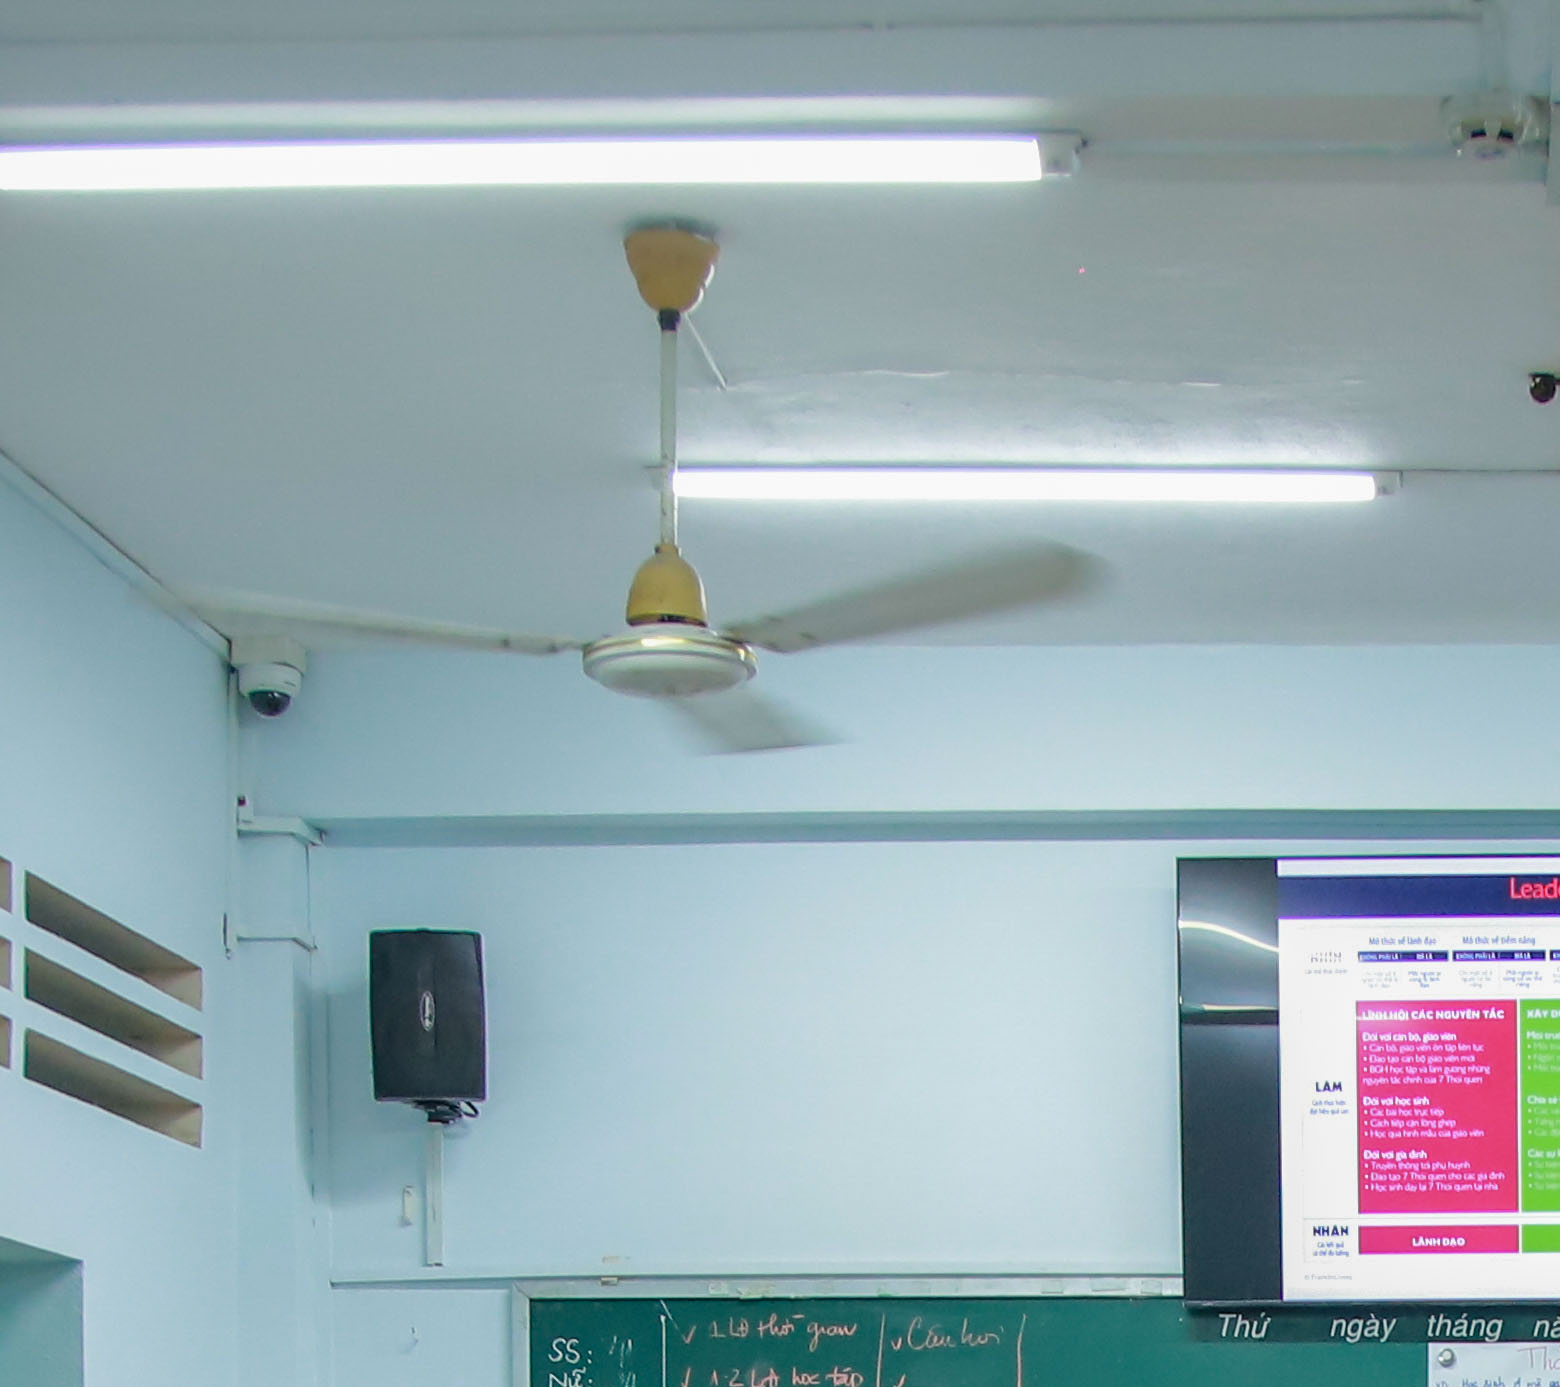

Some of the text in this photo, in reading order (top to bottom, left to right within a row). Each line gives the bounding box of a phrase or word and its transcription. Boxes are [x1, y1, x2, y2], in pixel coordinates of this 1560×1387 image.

[1218, 1312, 1272, 1339] Thứ
[1330, 1313, 1397, 1343] ngày
[1427, 1313, 1503, 1341] tháng
